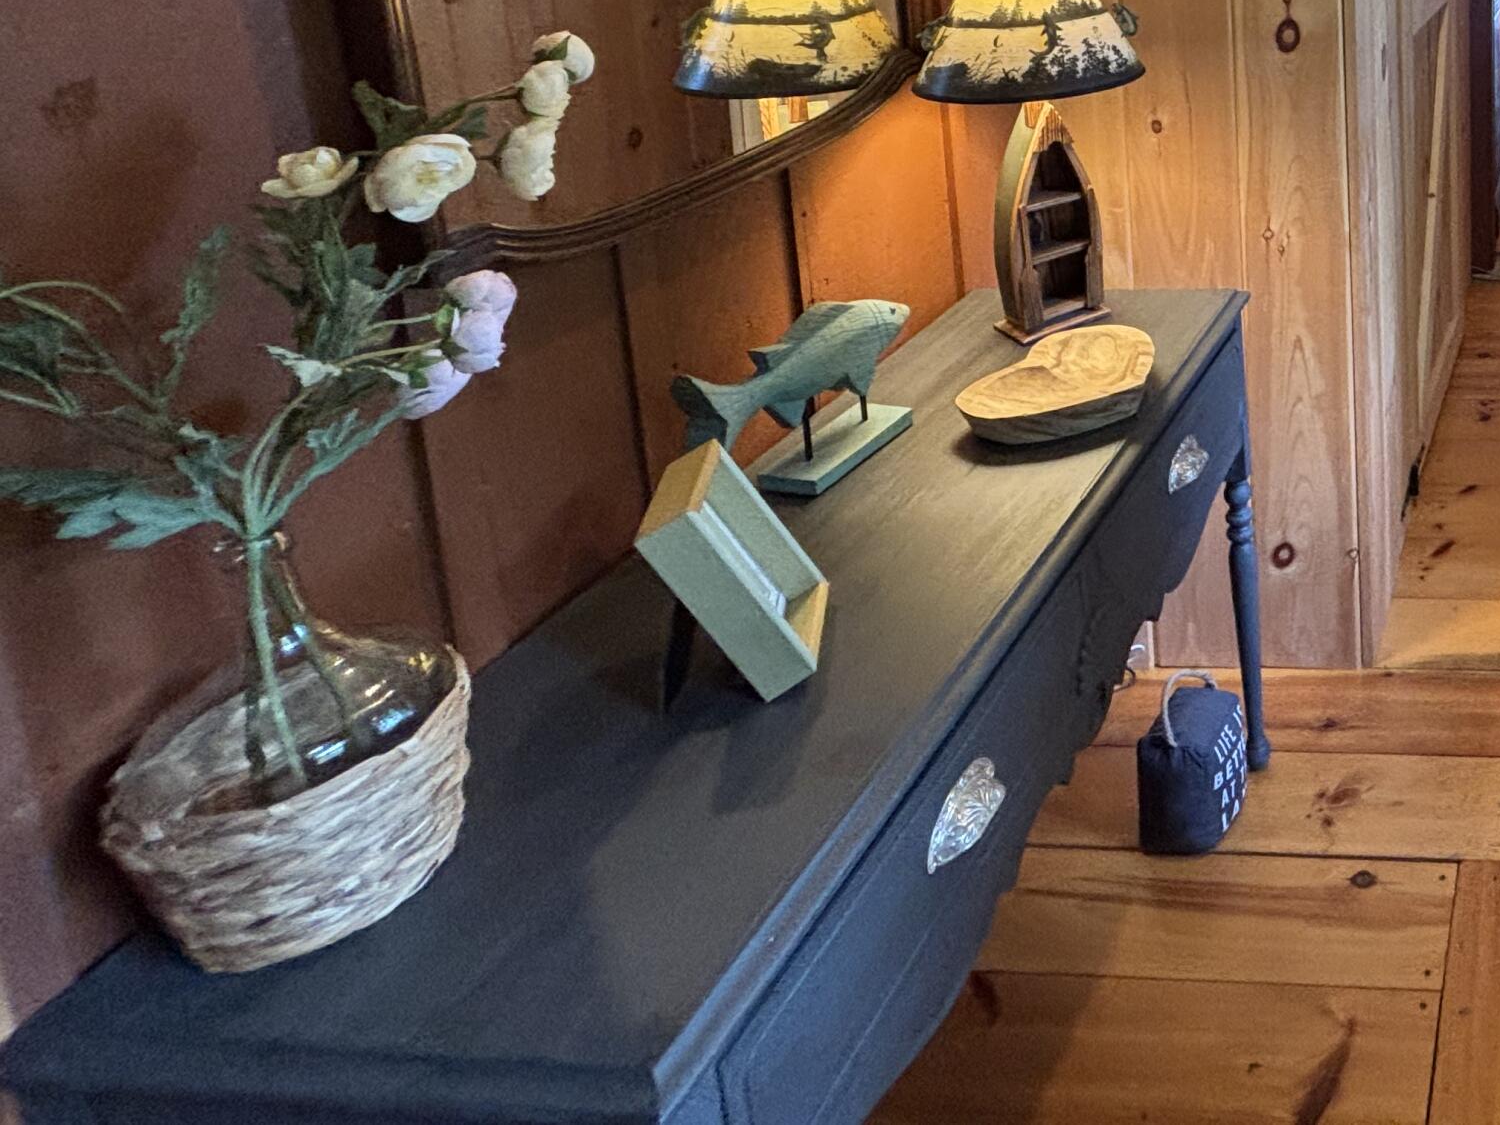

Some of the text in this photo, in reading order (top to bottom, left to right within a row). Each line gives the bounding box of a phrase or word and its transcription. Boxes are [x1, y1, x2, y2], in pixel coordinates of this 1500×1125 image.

[1213, 731, 1246, 790] BETT
[1214, 724, 1237, 763] LIFE
[1221, 779, 1236, 808] AT
